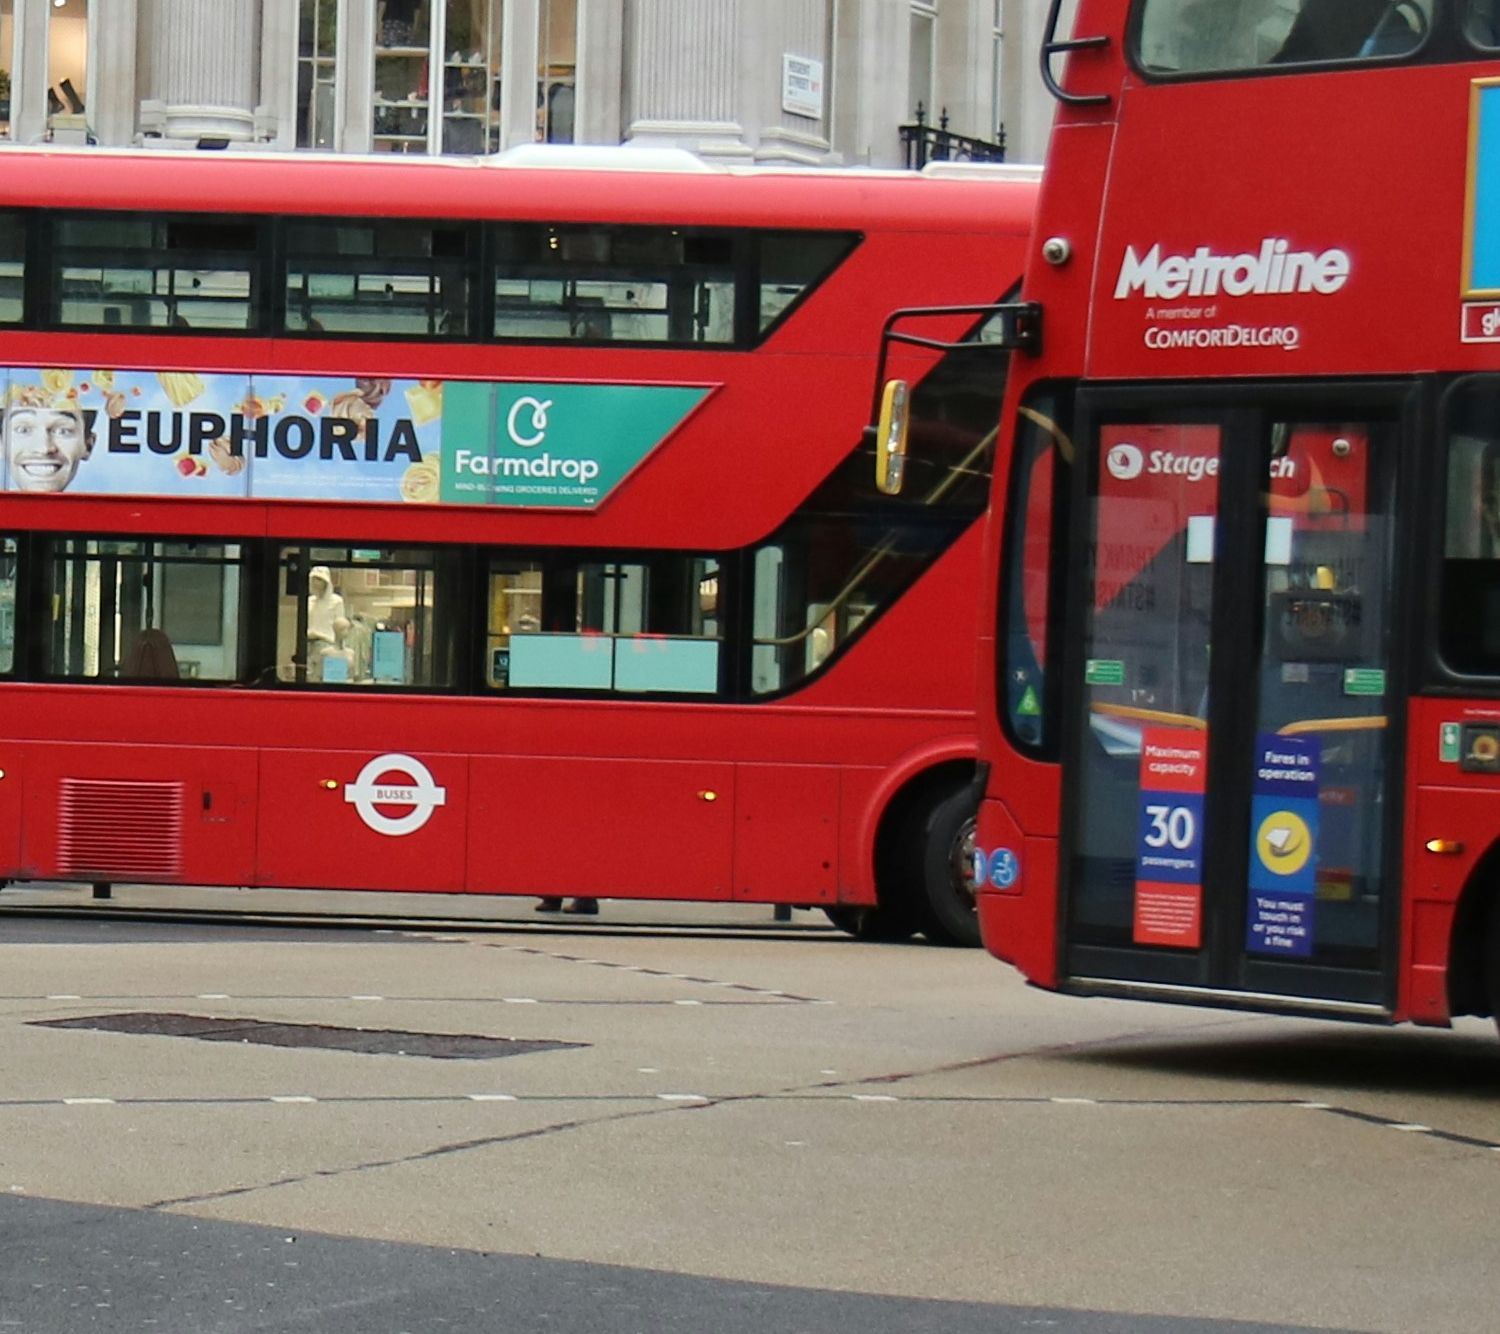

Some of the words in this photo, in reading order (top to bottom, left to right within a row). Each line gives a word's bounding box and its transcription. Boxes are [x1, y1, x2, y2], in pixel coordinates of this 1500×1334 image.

[1113, 238, 1351, 300] Metroline
[1145, 308, 1155, 320] A
[1156, 306, 1201, 320] member
[1204, 305, 1217, 318] of
[107, 409, 424, 464] EUPHORIA
[455, 450, 600, 484] Farmdrop
[1145, 745, 1200, 760] Maximum
[1264, 750, 1296, 766] Fares
[1297, 752, 1310, 766] in
[1149, 761, 1196, 776] capacity
[1258, 767, 1315, 782] operation
[376, 789, 414, 800] BUSES
[1143, 805, 1195, 850] 30
[1142, 855, 1195, 869] passengers
[1256, 897, 1276, 910] You
[1278, 899, 1305, 911] must
[1259, 910, 1288, 922] touch
[1289, 912, 1301, 923] in
[1252, 923, 1265, 932] or
[1266, 925, 1285, 937] you
[1286, 924, 1306, 936] risk
[1273, 936, 1293, 948] fine
